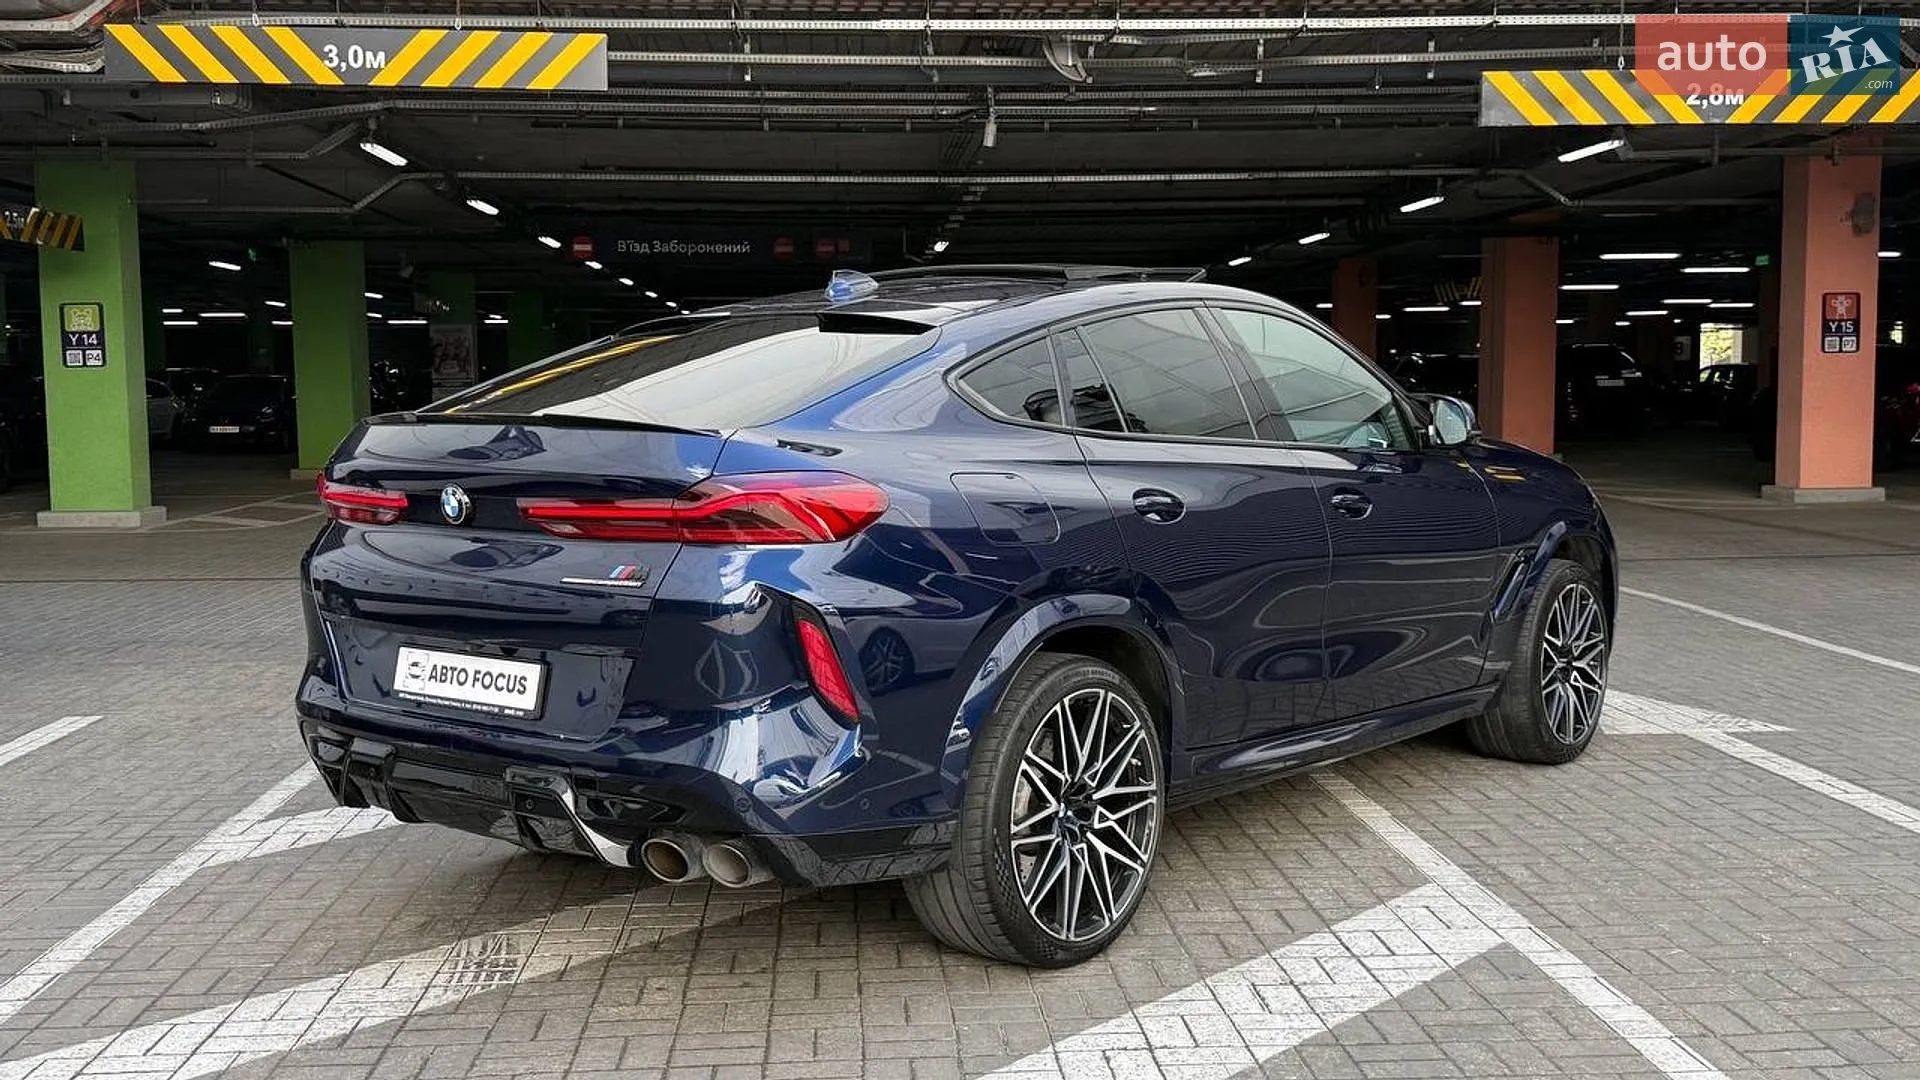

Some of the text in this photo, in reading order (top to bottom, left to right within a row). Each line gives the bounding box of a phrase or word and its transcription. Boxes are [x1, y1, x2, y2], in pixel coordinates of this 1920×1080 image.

[323, 43, 386, 72] 3,0м
[652, 239, 751, 257] Заборонений
[1828, 320, 1854, 333] Y 15
[68, 333, 98, 346] Y 14
[471, 669, 528, 696] FOCUS
